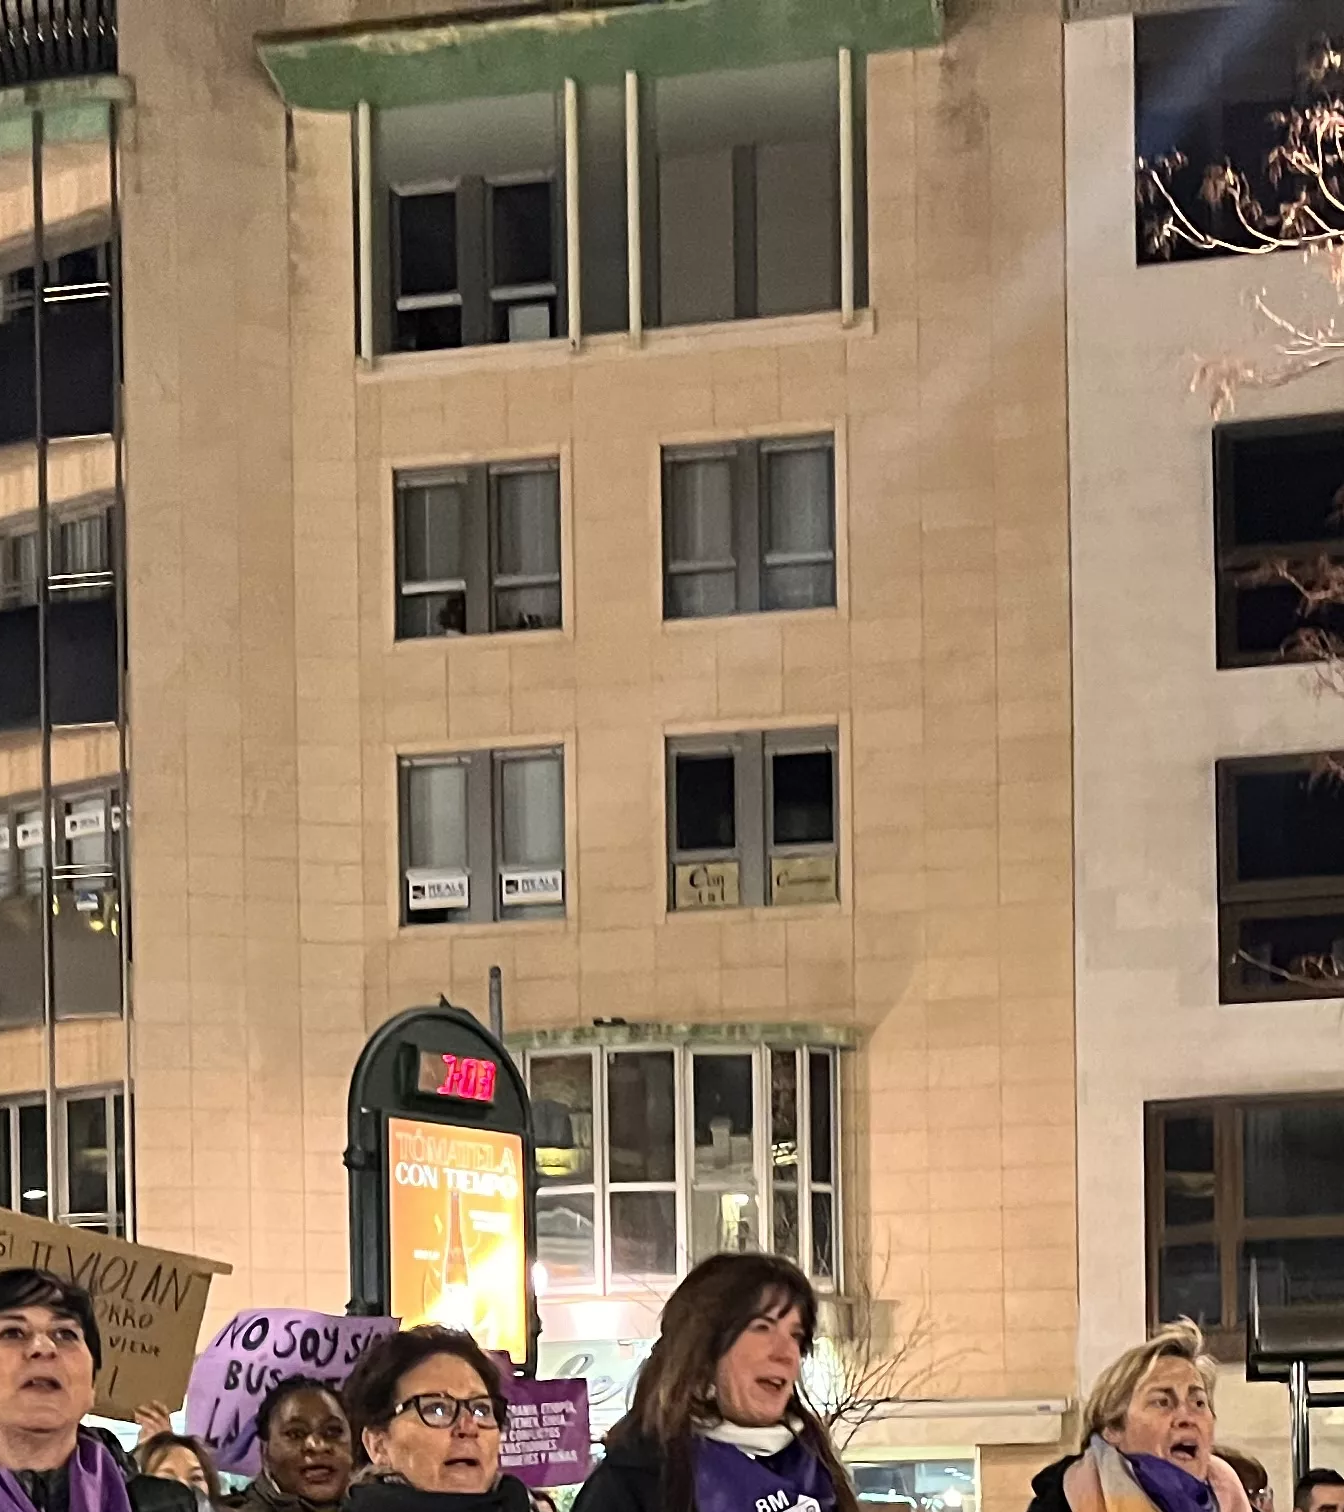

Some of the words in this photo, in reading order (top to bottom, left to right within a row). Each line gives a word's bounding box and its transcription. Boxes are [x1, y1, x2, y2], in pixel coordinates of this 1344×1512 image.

[395, 1161, 439, 1189] CON
[443, 1168, 518, 1199] TIEMPO
[67, 1245, 193, 1312] VIOLAN
[216, 1317, 269, 1351] NO
[273, 1319, 339, 1368] SOY
